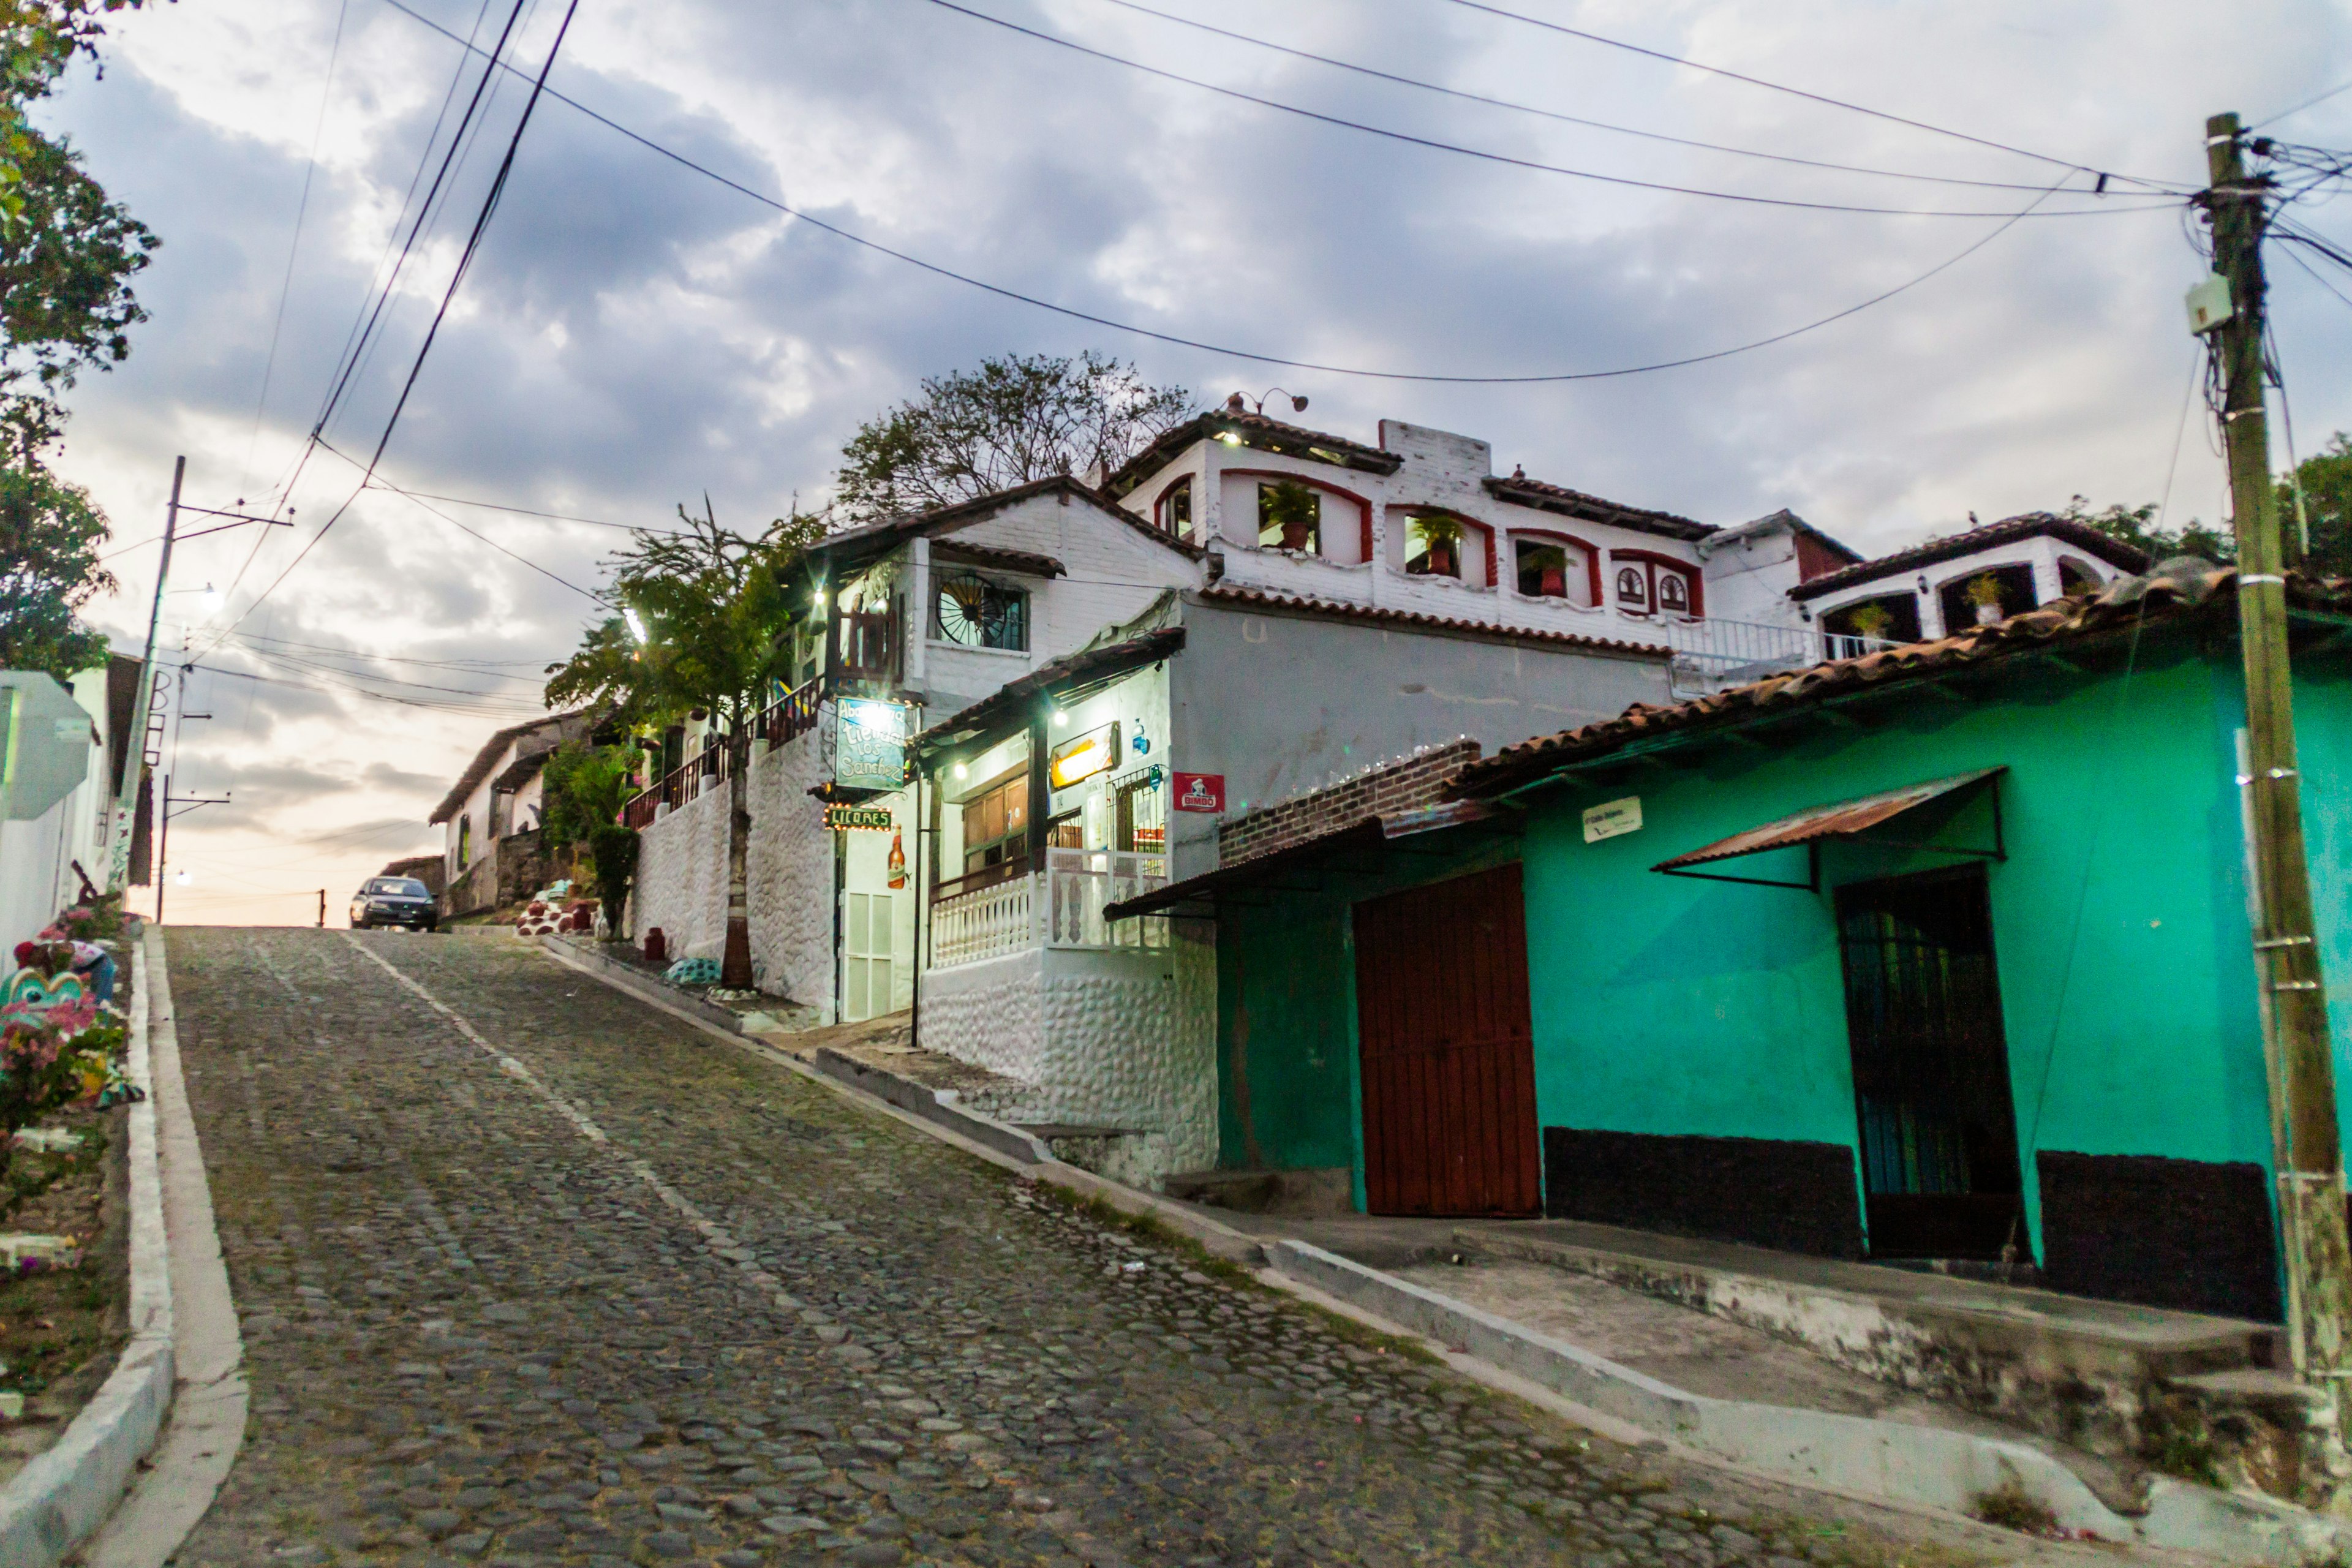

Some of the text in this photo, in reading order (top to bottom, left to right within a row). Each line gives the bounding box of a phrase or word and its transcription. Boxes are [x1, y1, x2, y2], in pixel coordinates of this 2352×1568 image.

[843, 721, 902, 747] tienda
[1185, 796, 1213, 806] BIMBO
[832, 810, 888, 826] LICORES
